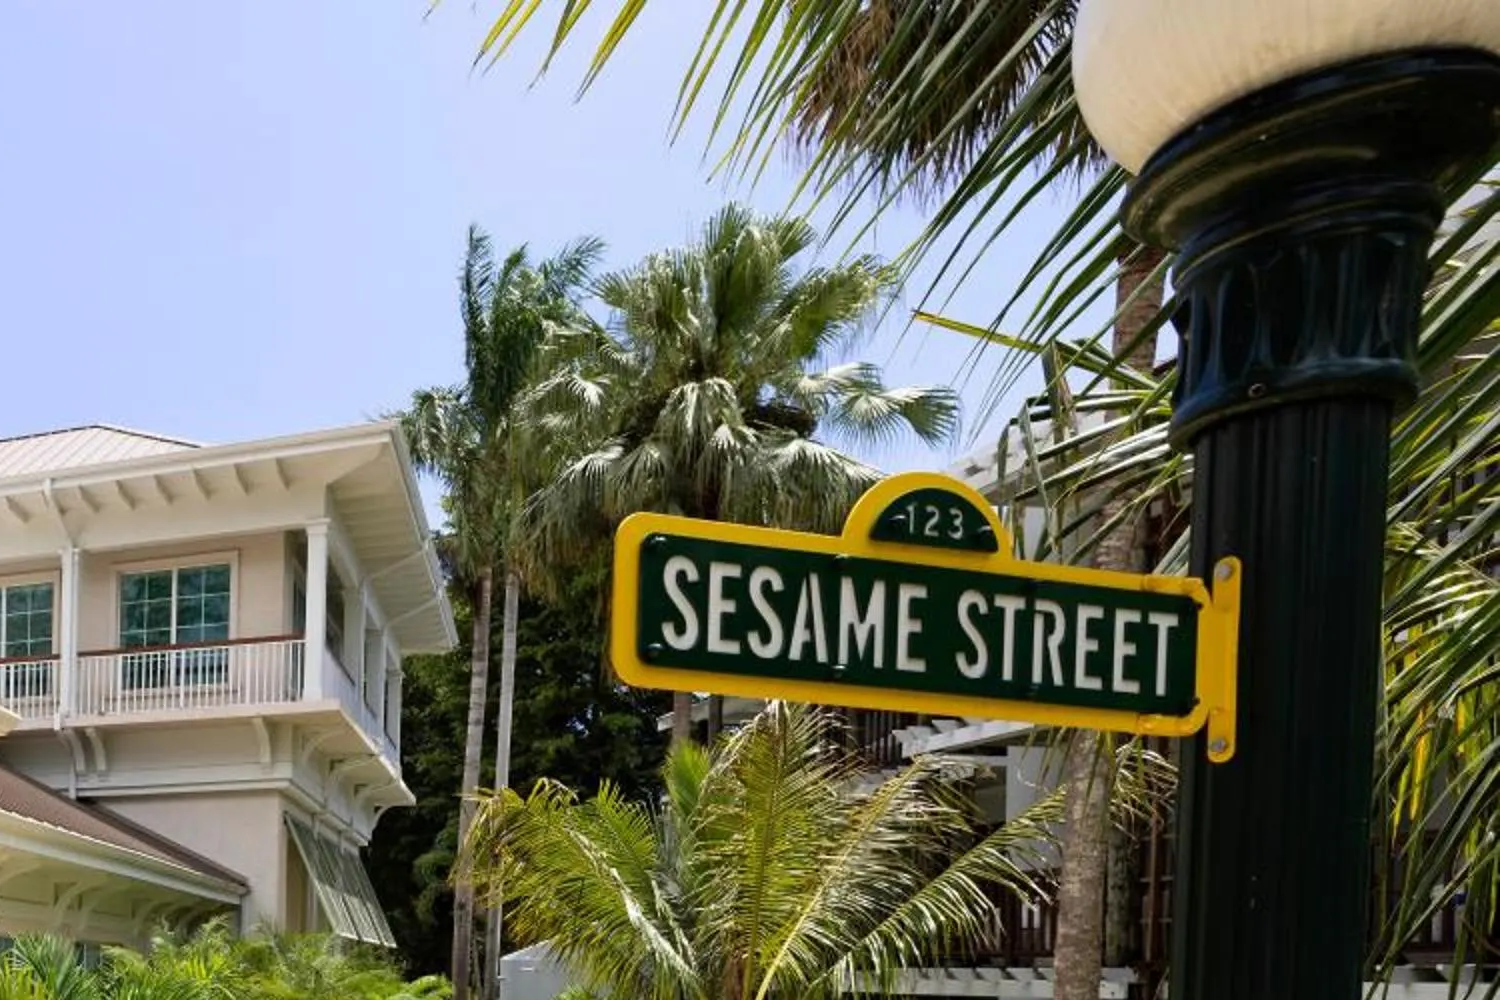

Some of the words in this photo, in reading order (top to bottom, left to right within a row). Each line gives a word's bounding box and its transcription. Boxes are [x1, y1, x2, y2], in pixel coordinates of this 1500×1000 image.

[904, 504, 965, 540] 123
[661, 554, 928, 674] SESAME
[956, 588, 1180, 698] STREET
